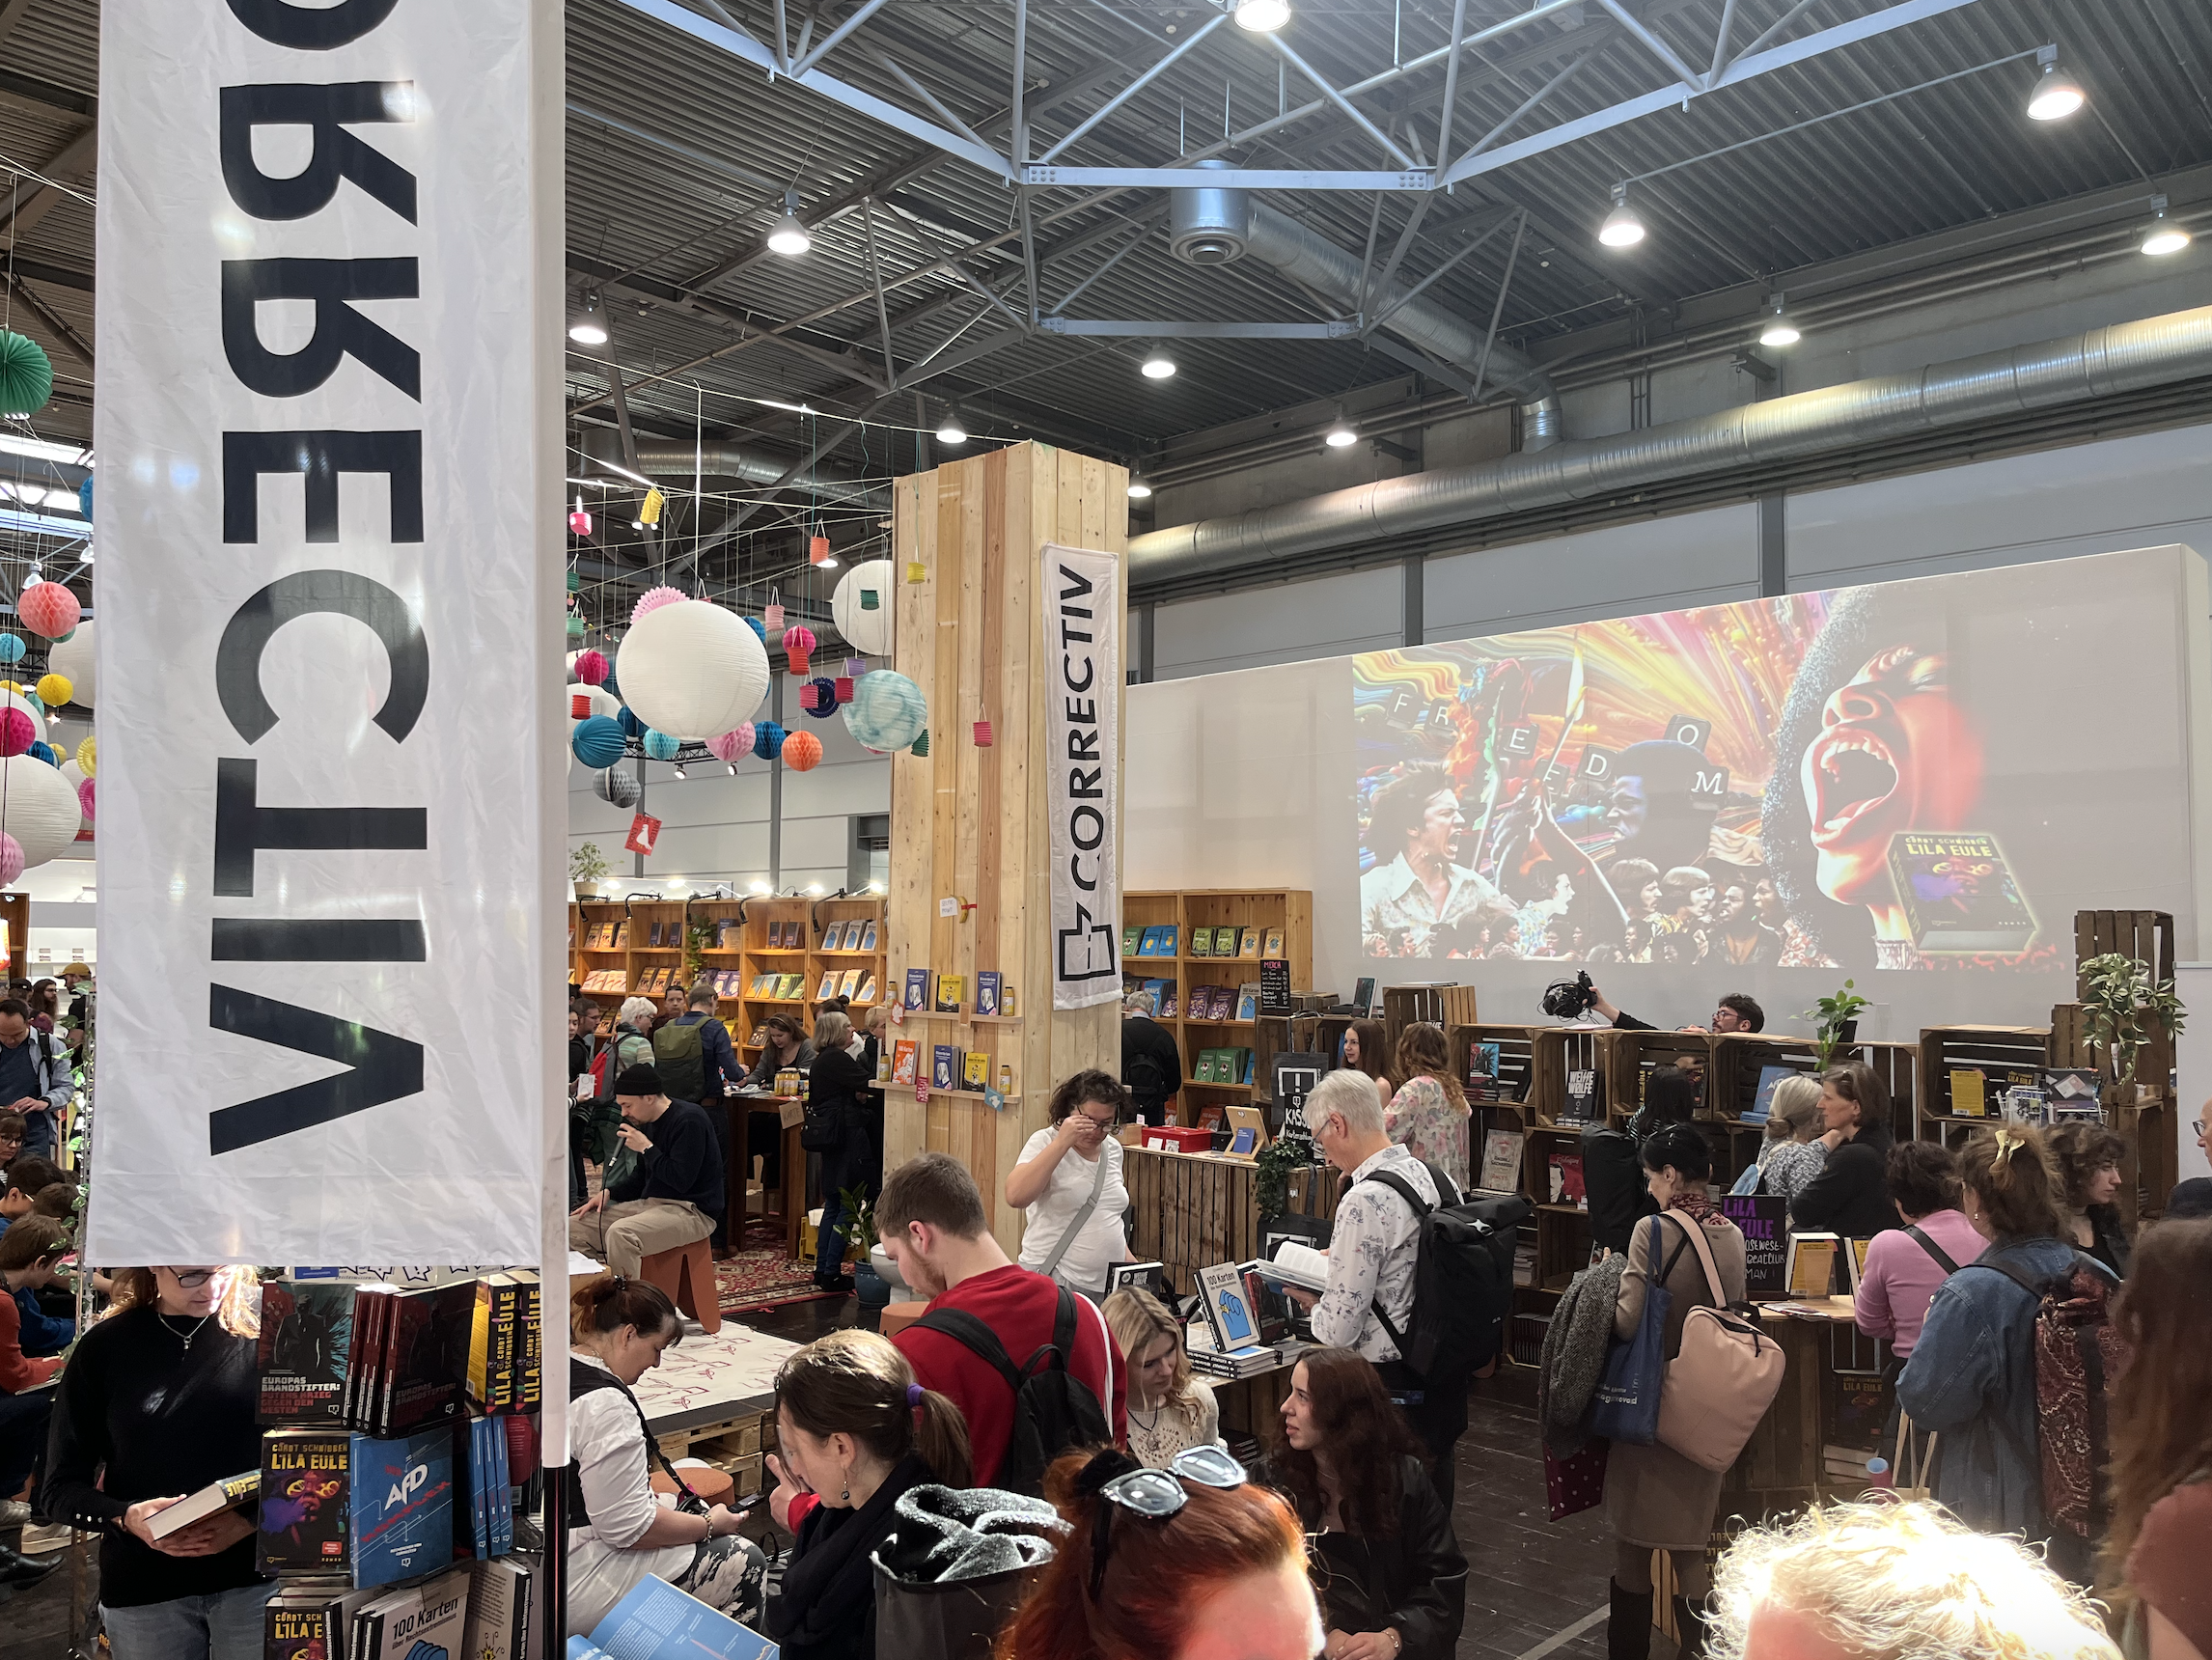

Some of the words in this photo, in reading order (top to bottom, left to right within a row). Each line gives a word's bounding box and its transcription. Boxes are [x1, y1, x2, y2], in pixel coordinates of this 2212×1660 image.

[1059, 564, 1104, 892] CORRECTIV
[1906, 844, 1947, 855] LILA
[1949, 845, 1993, 856] EULE
[1206, 1274, 1217, 1286] 100
[1217, 1272, 1235, 1284] Karten
[1745, 1268, 1767, 1280] MAN
[498, 1291, 515, 1332] EULE
[262, 1376, 307, 1385] EUROPAS
[495, 1370, 512, 1405] LILA
[524, 1368, 540, 1402] LILA
[271, 1453, 306, 1470] LILA
[311, 1454, 347, 1470] EULE
[393, 1615, 414, 1640] 100
[417, 1598, 457, 1627] Karten
[275, 1623, 309, 1639] LILA
